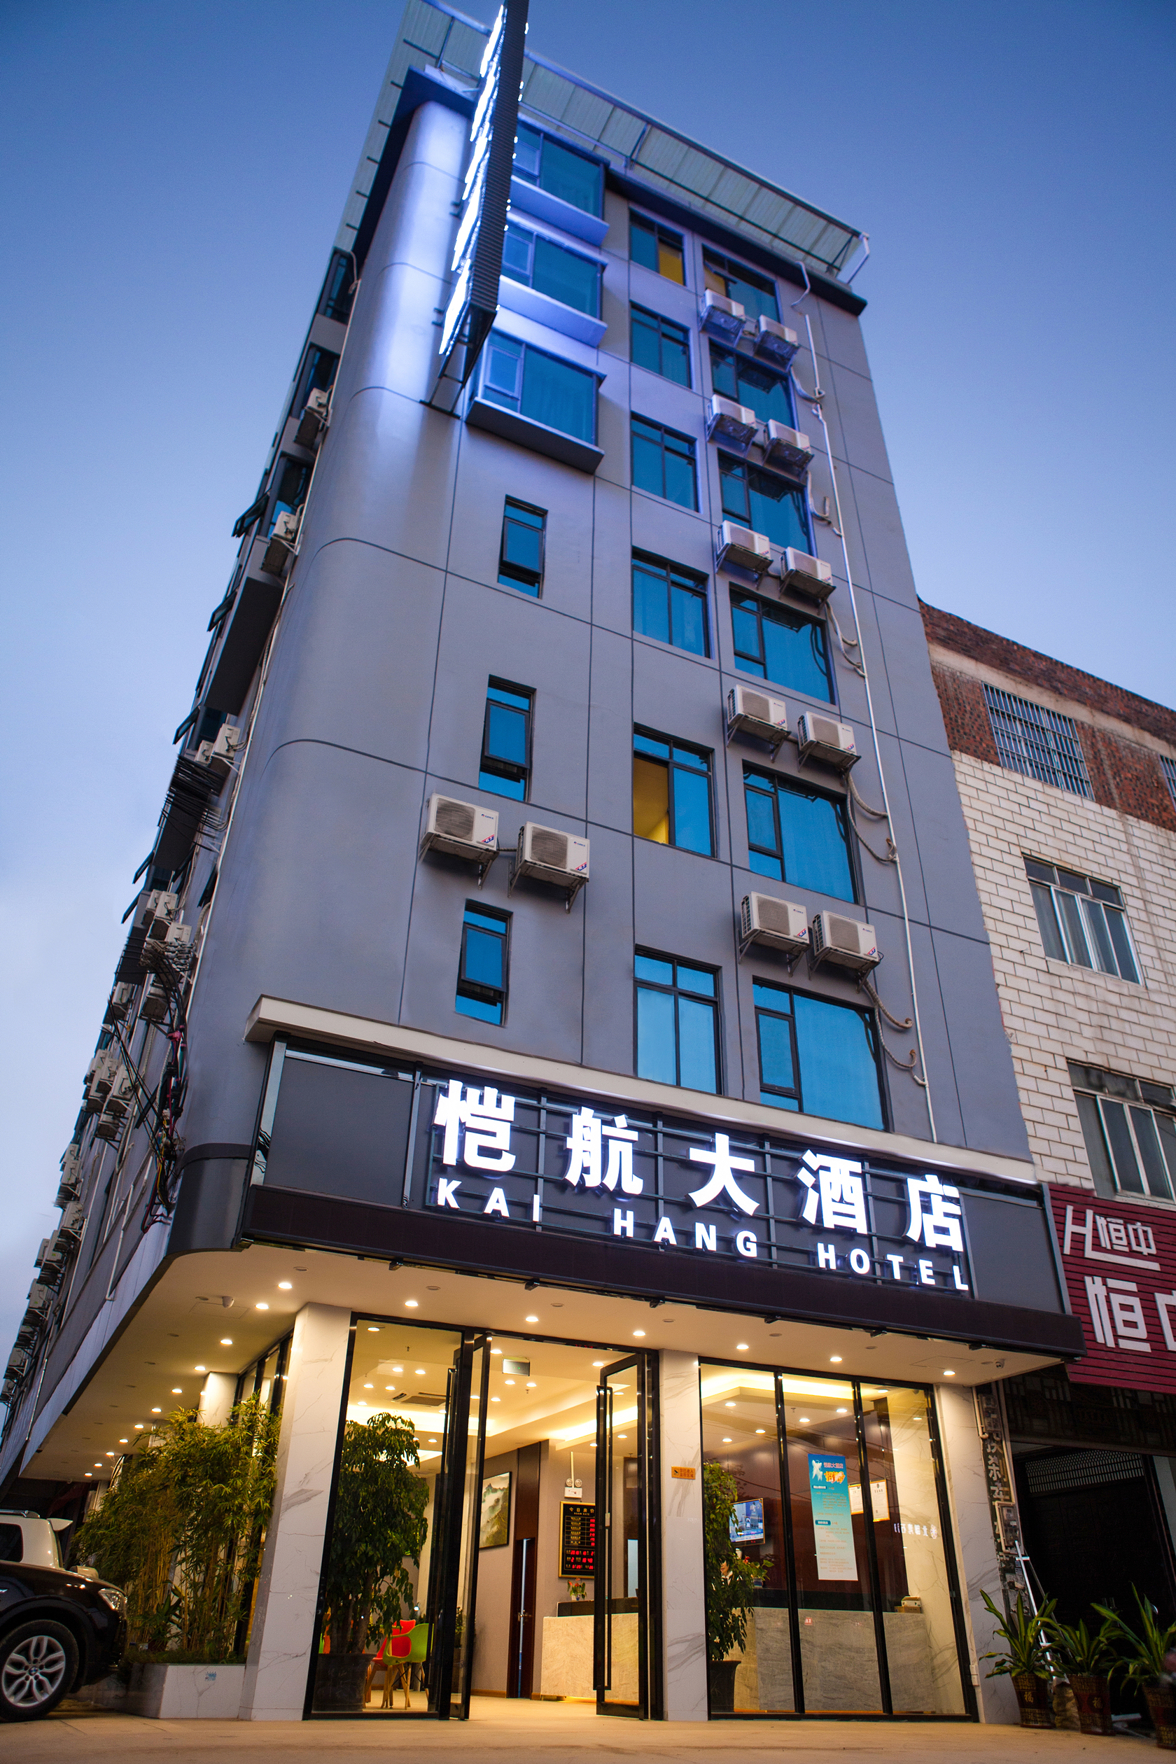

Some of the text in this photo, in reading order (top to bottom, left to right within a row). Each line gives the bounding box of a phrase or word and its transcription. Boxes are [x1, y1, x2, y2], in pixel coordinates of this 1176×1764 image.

[434, 1079, 964, 1253] 恺航大酒店
[437, 1178, 970, 1292] KAI HANG HOTEL
